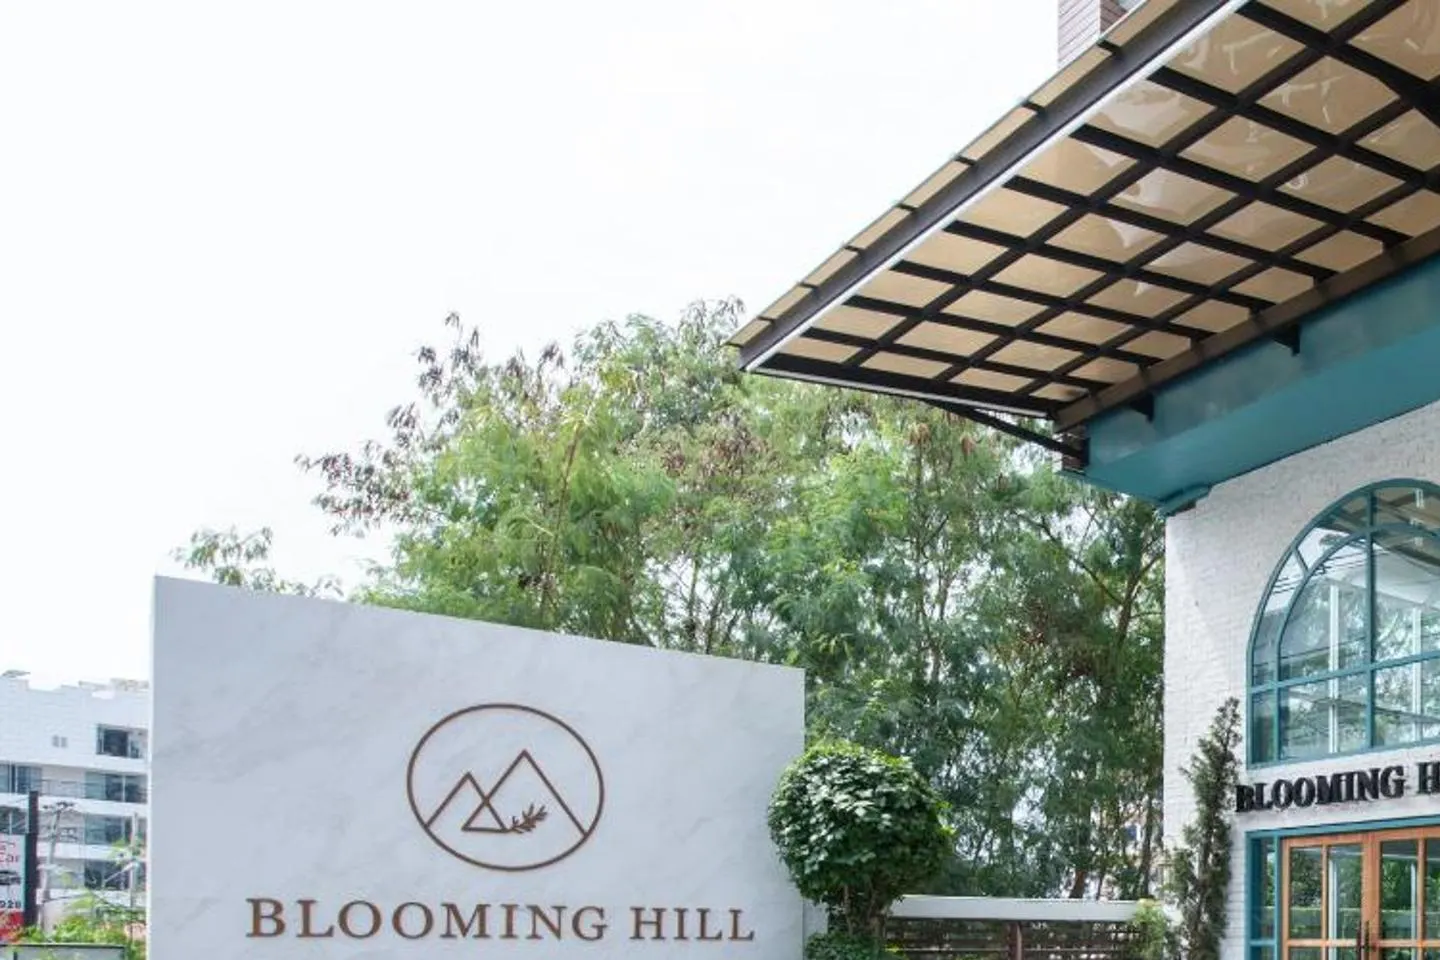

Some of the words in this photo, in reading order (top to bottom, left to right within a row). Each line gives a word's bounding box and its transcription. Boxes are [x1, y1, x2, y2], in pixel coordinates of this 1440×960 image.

[1236, 765, 1406, 812] BLOOMING
[246, 898, 608, 942] BLOOMING
[629, 906, 755, 942] HILL
